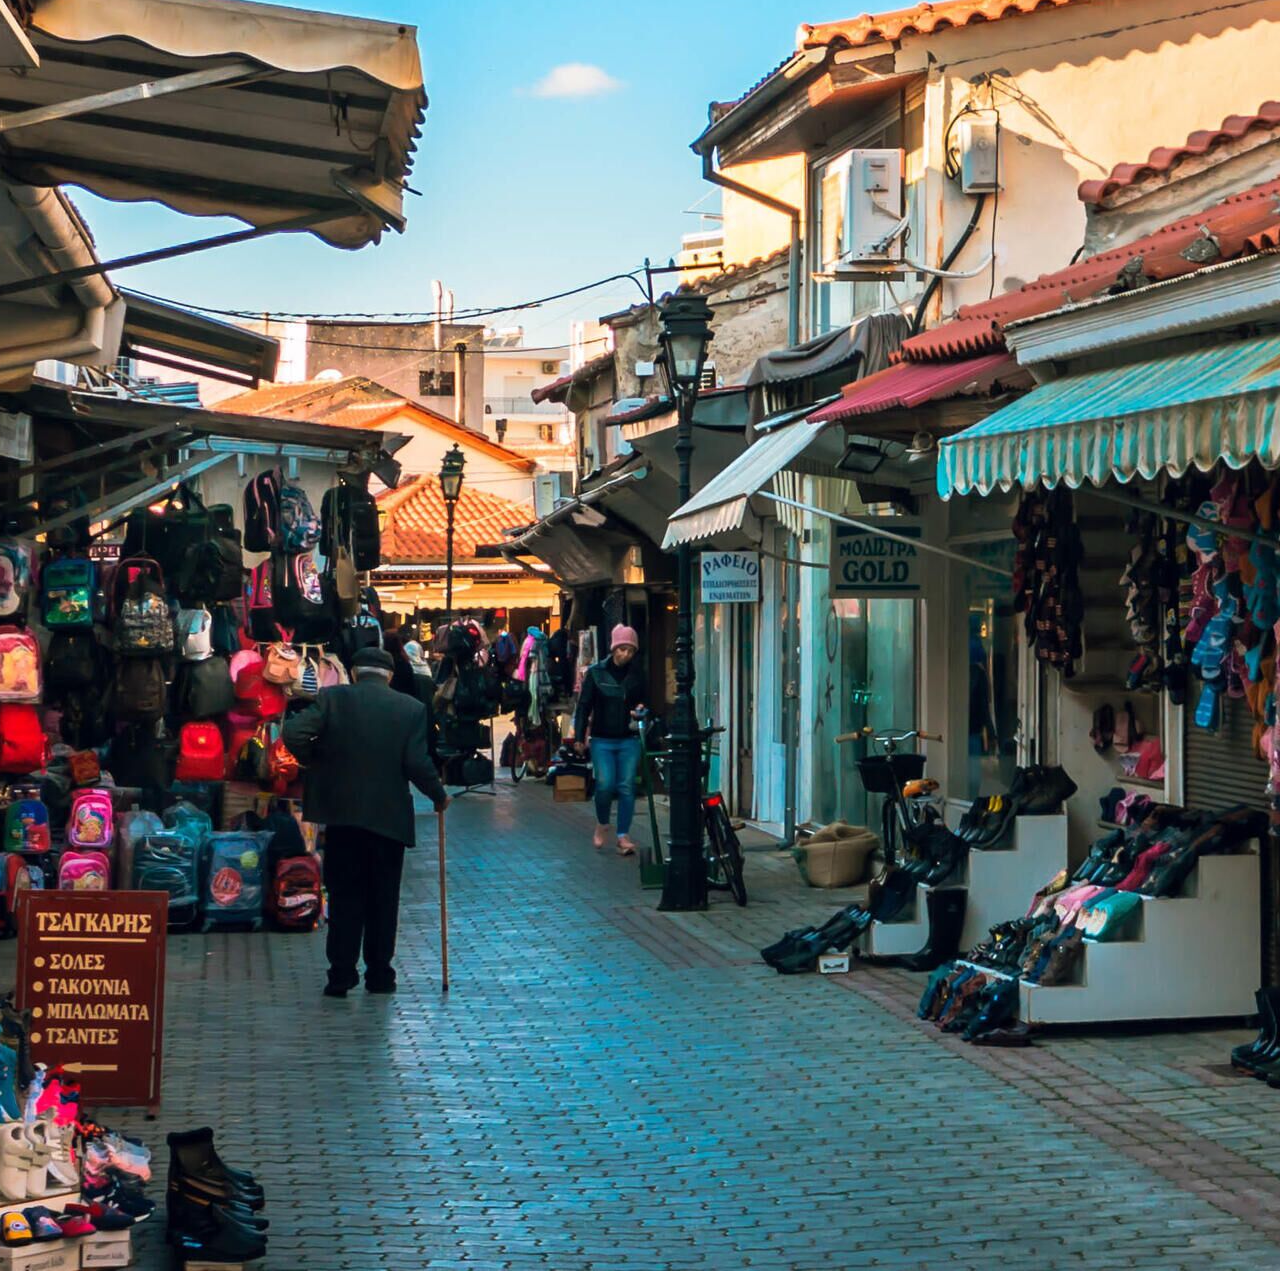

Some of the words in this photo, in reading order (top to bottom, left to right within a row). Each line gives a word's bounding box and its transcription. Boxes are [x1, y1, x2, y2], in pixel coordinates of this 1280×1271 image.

[703, 553, 758, 576] ΡΑΦΕΙΟ
[842, 560, 910, 583] GOLD
[35, 912, 152, 934] ΤΣΑΓΚΑΡΗΣ
[49, 954, 105, 970] ΣΟΛΕΣ
[48, 978, 131, 996] ΤΑΚΟΥΝΙΑ
[46, 1003, 150, 1021] ΜΠΑΛΩΜΑΤΑ
[45, 1028, 119, 1045] ΤΣΑΝΤΕΣ
